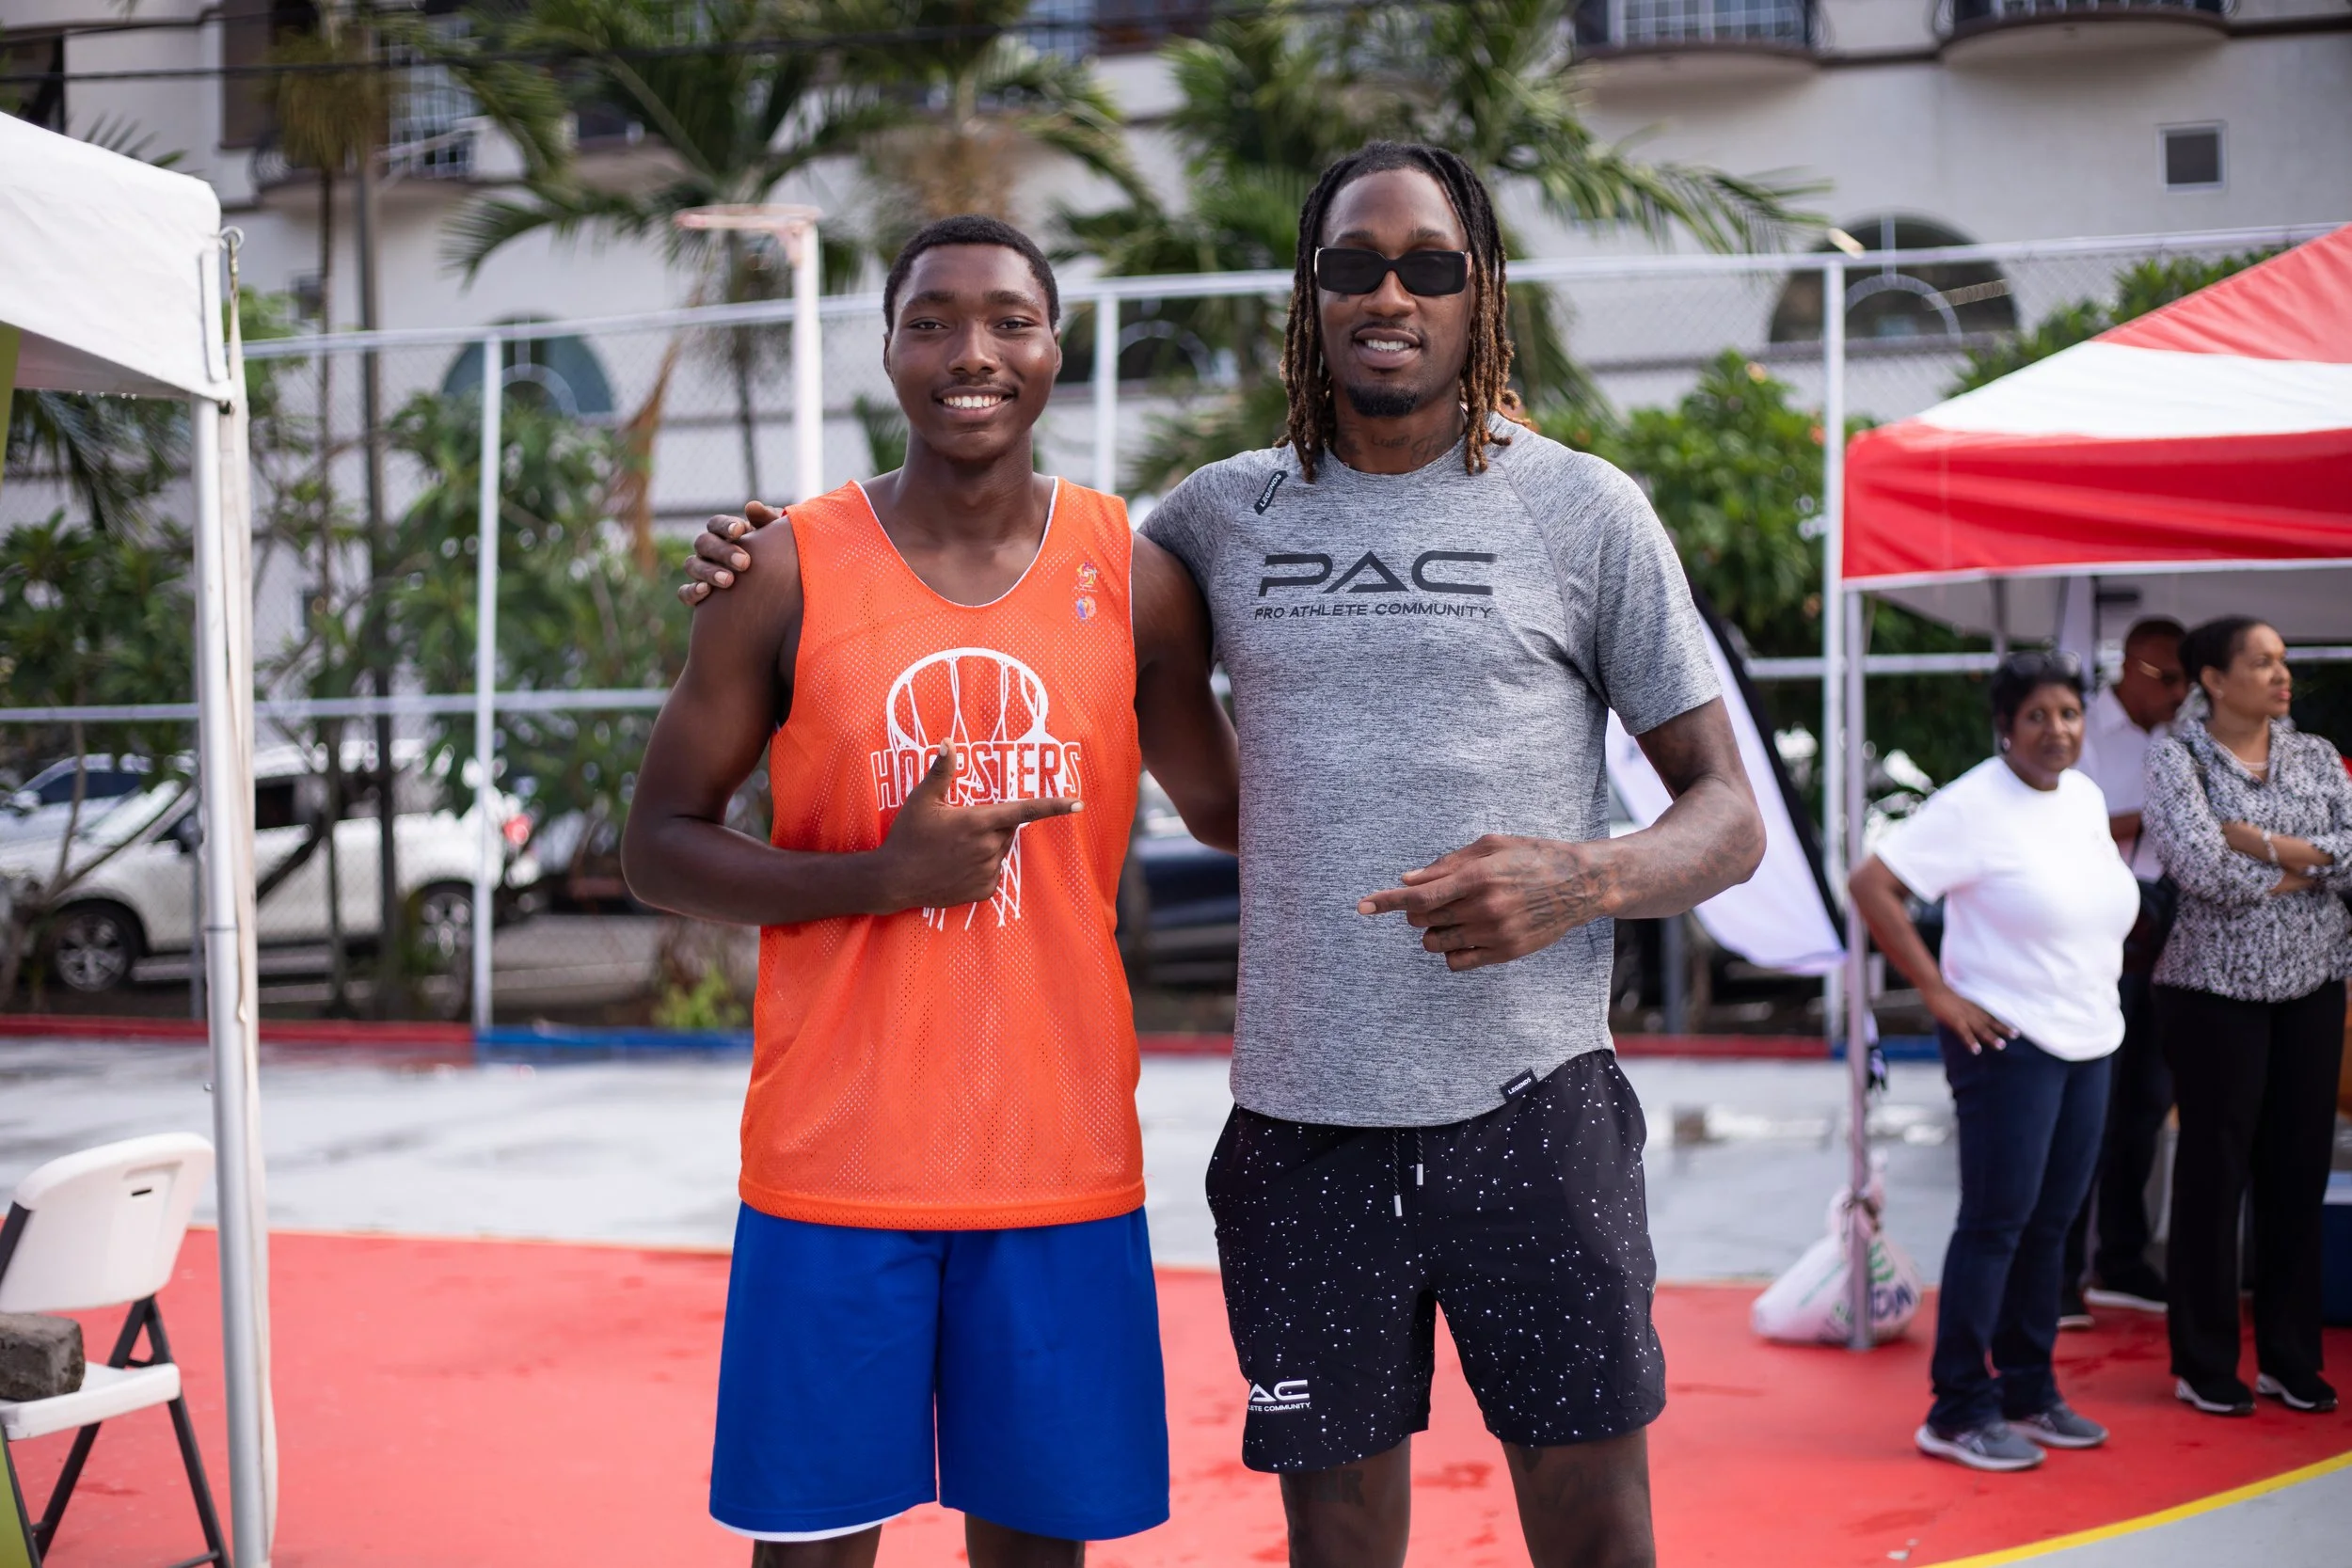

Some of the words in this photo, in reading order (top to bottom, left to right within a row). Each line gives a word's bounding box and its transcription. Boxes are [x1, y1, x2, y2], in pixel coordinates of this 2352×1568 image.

[1259, 473, 1282, 508] LEGENDS
[1258, 550, 1498, 596] PAC
[1254, 607, 1285, 620] PRO
[1288, 604, 1369, 618] ATHLETE
[1375, 602, 1493, 619] COMMUNITY
[1507, 1076, 1532, 1095] LEGENDS
[1248, 1379, 1311, 1402] AC
[1263, 1402, 1311, 1412] COMMUNITY
